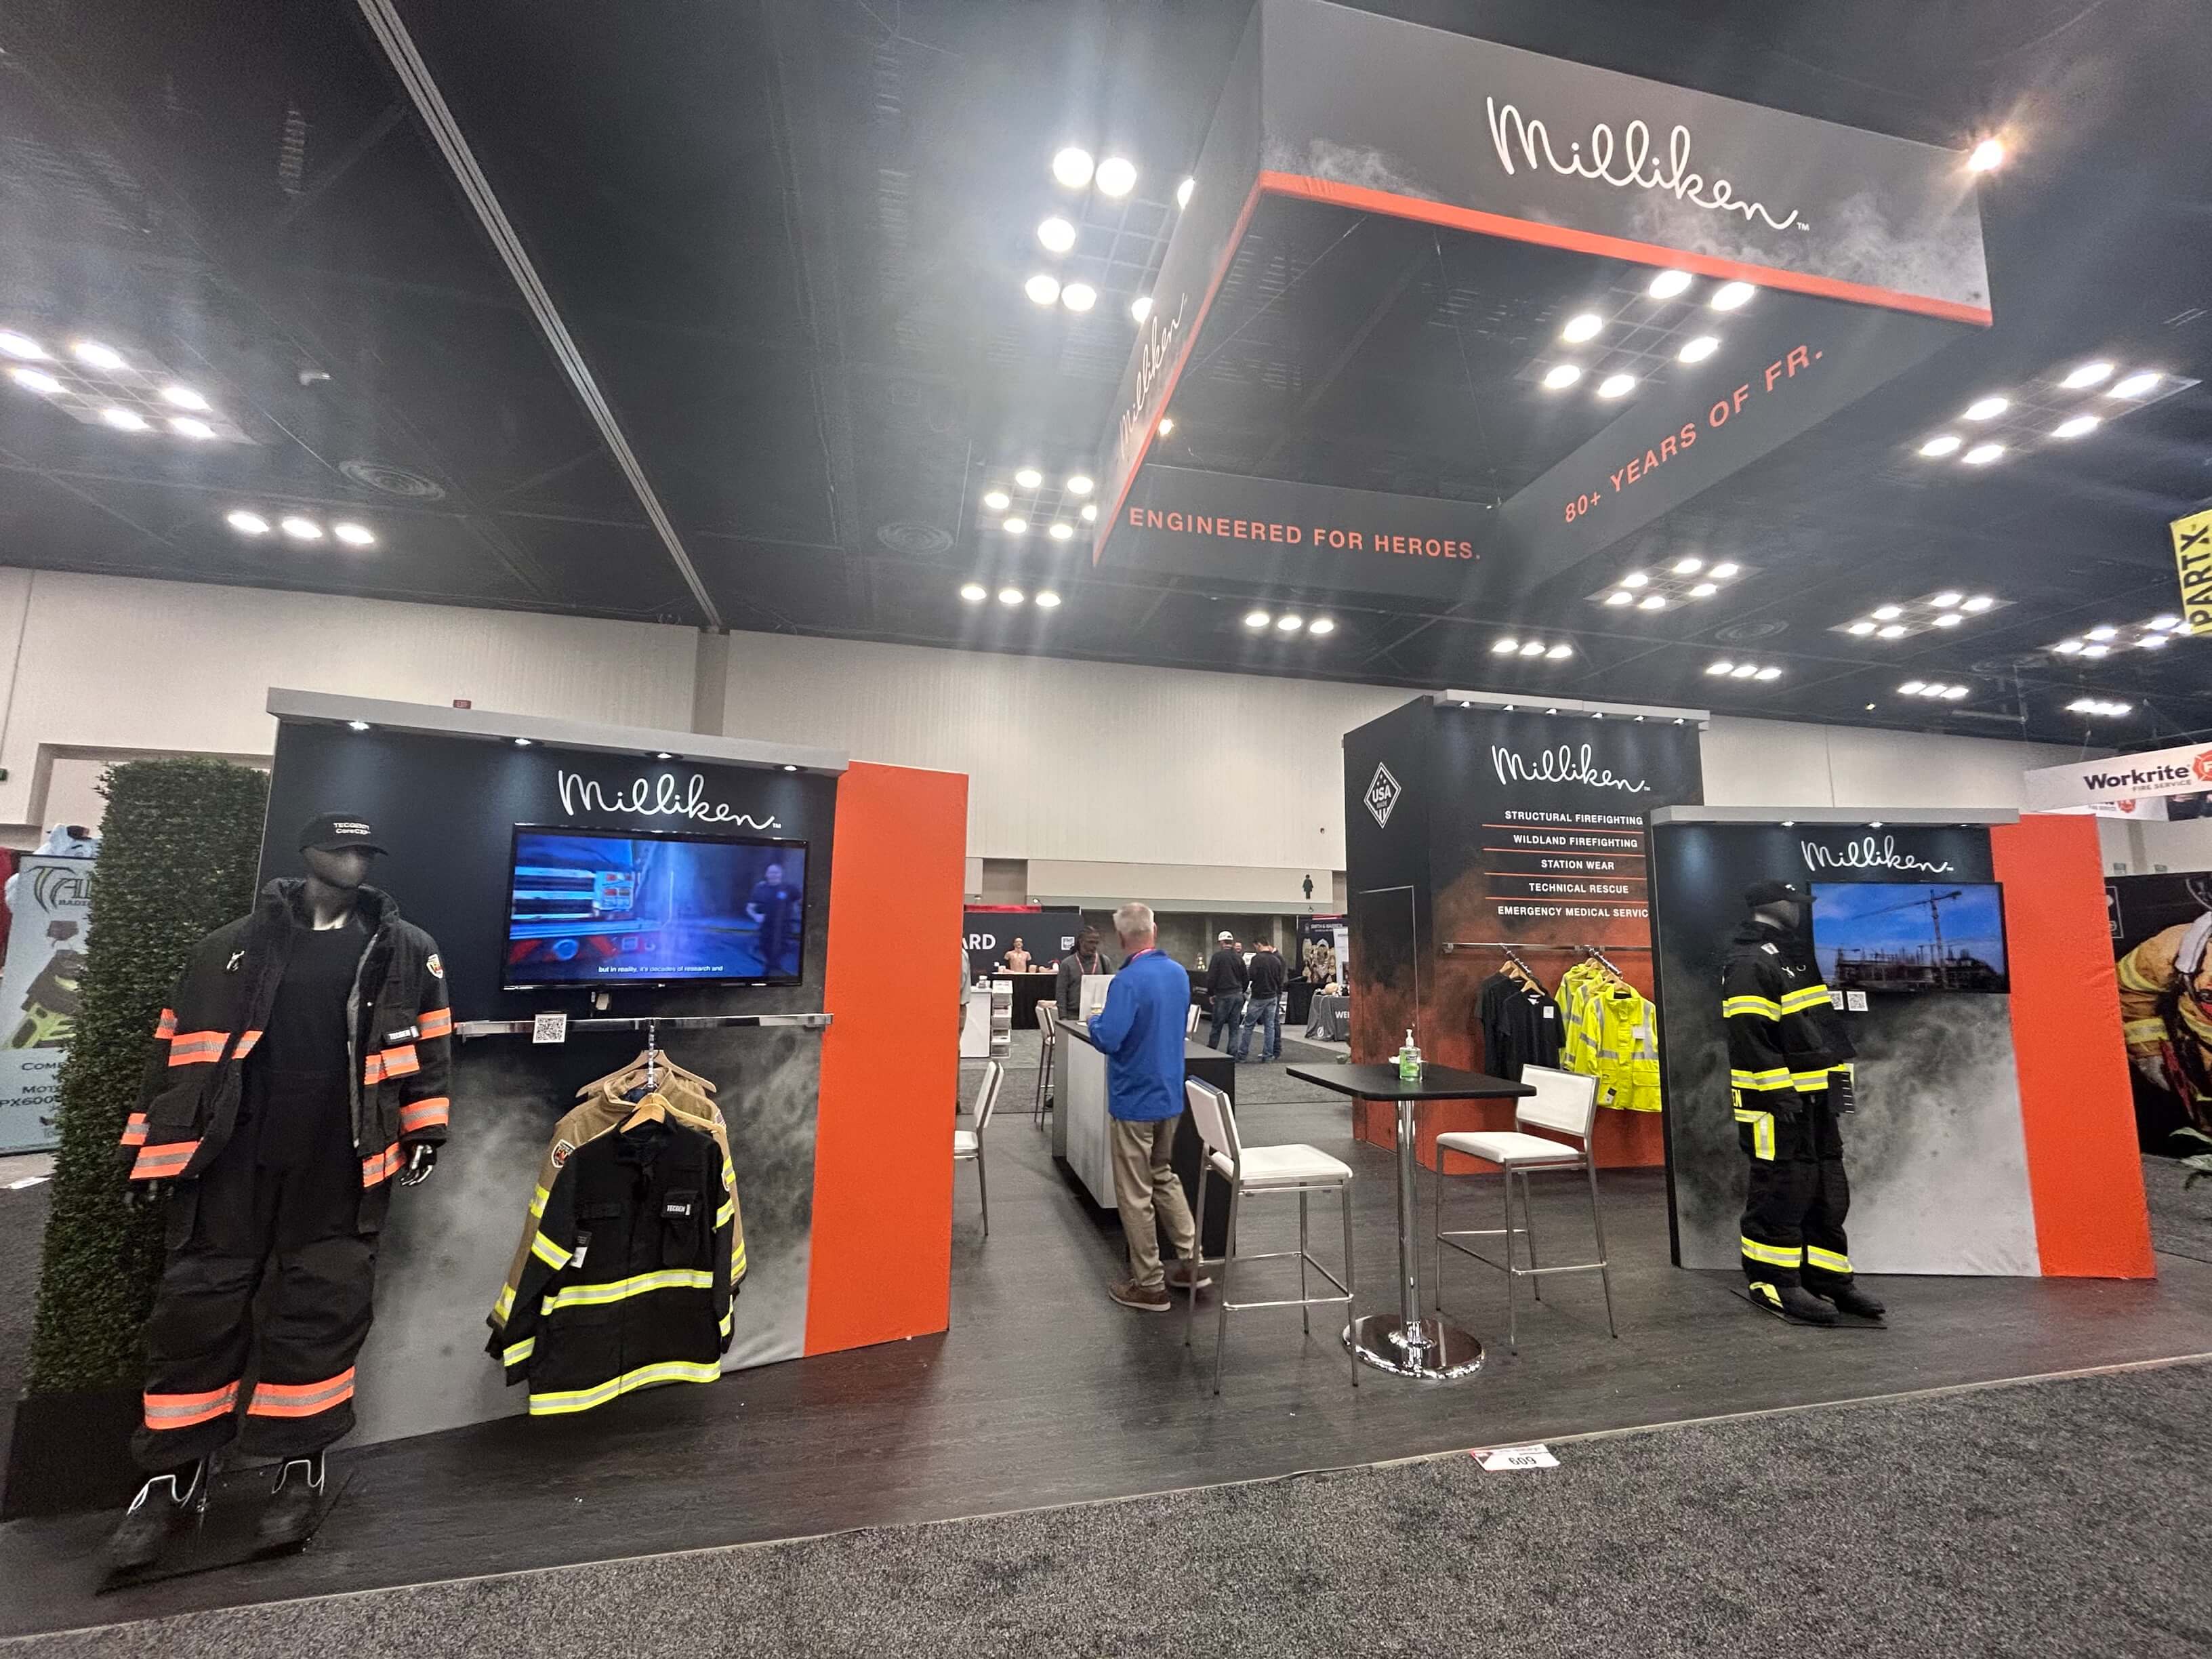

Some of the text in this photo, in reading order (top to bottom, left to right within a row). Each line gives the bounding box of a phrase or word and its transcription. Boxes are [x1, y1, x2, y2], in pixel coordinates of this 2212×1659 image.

[1487, 96, 1799, 229] Milliken
[1565, 345, 1822, 523] 80+ YEARS OF FR.
[1129, 508, 1481, 560] ENGINEERED FOR HEROES.
[1492, 743, 1645, 793] Milliken
[2083, 765, 2190, 790] Workrite
[1372, 785, 1391, 802] USA
[2154, 779, 2192, 790] SERVICE
[558, 770, 775, 830] Milliken
[1504, 811, 1643, 825] STRUCTURAL FIREFIGHTING
[1513, 835, 1638, 848] WILDLAND FIREFIGHTING
[1541, 859, 1614, 870] STATION WEAR
[1801, 835, 1948, 873] Milliken
[1529, 882, 1629, 894] TECHNICAL RESCUE
[1498, 906, 1562, 916] EMERGENCY
[1565, 907, 1610, 917] MEDICAL
